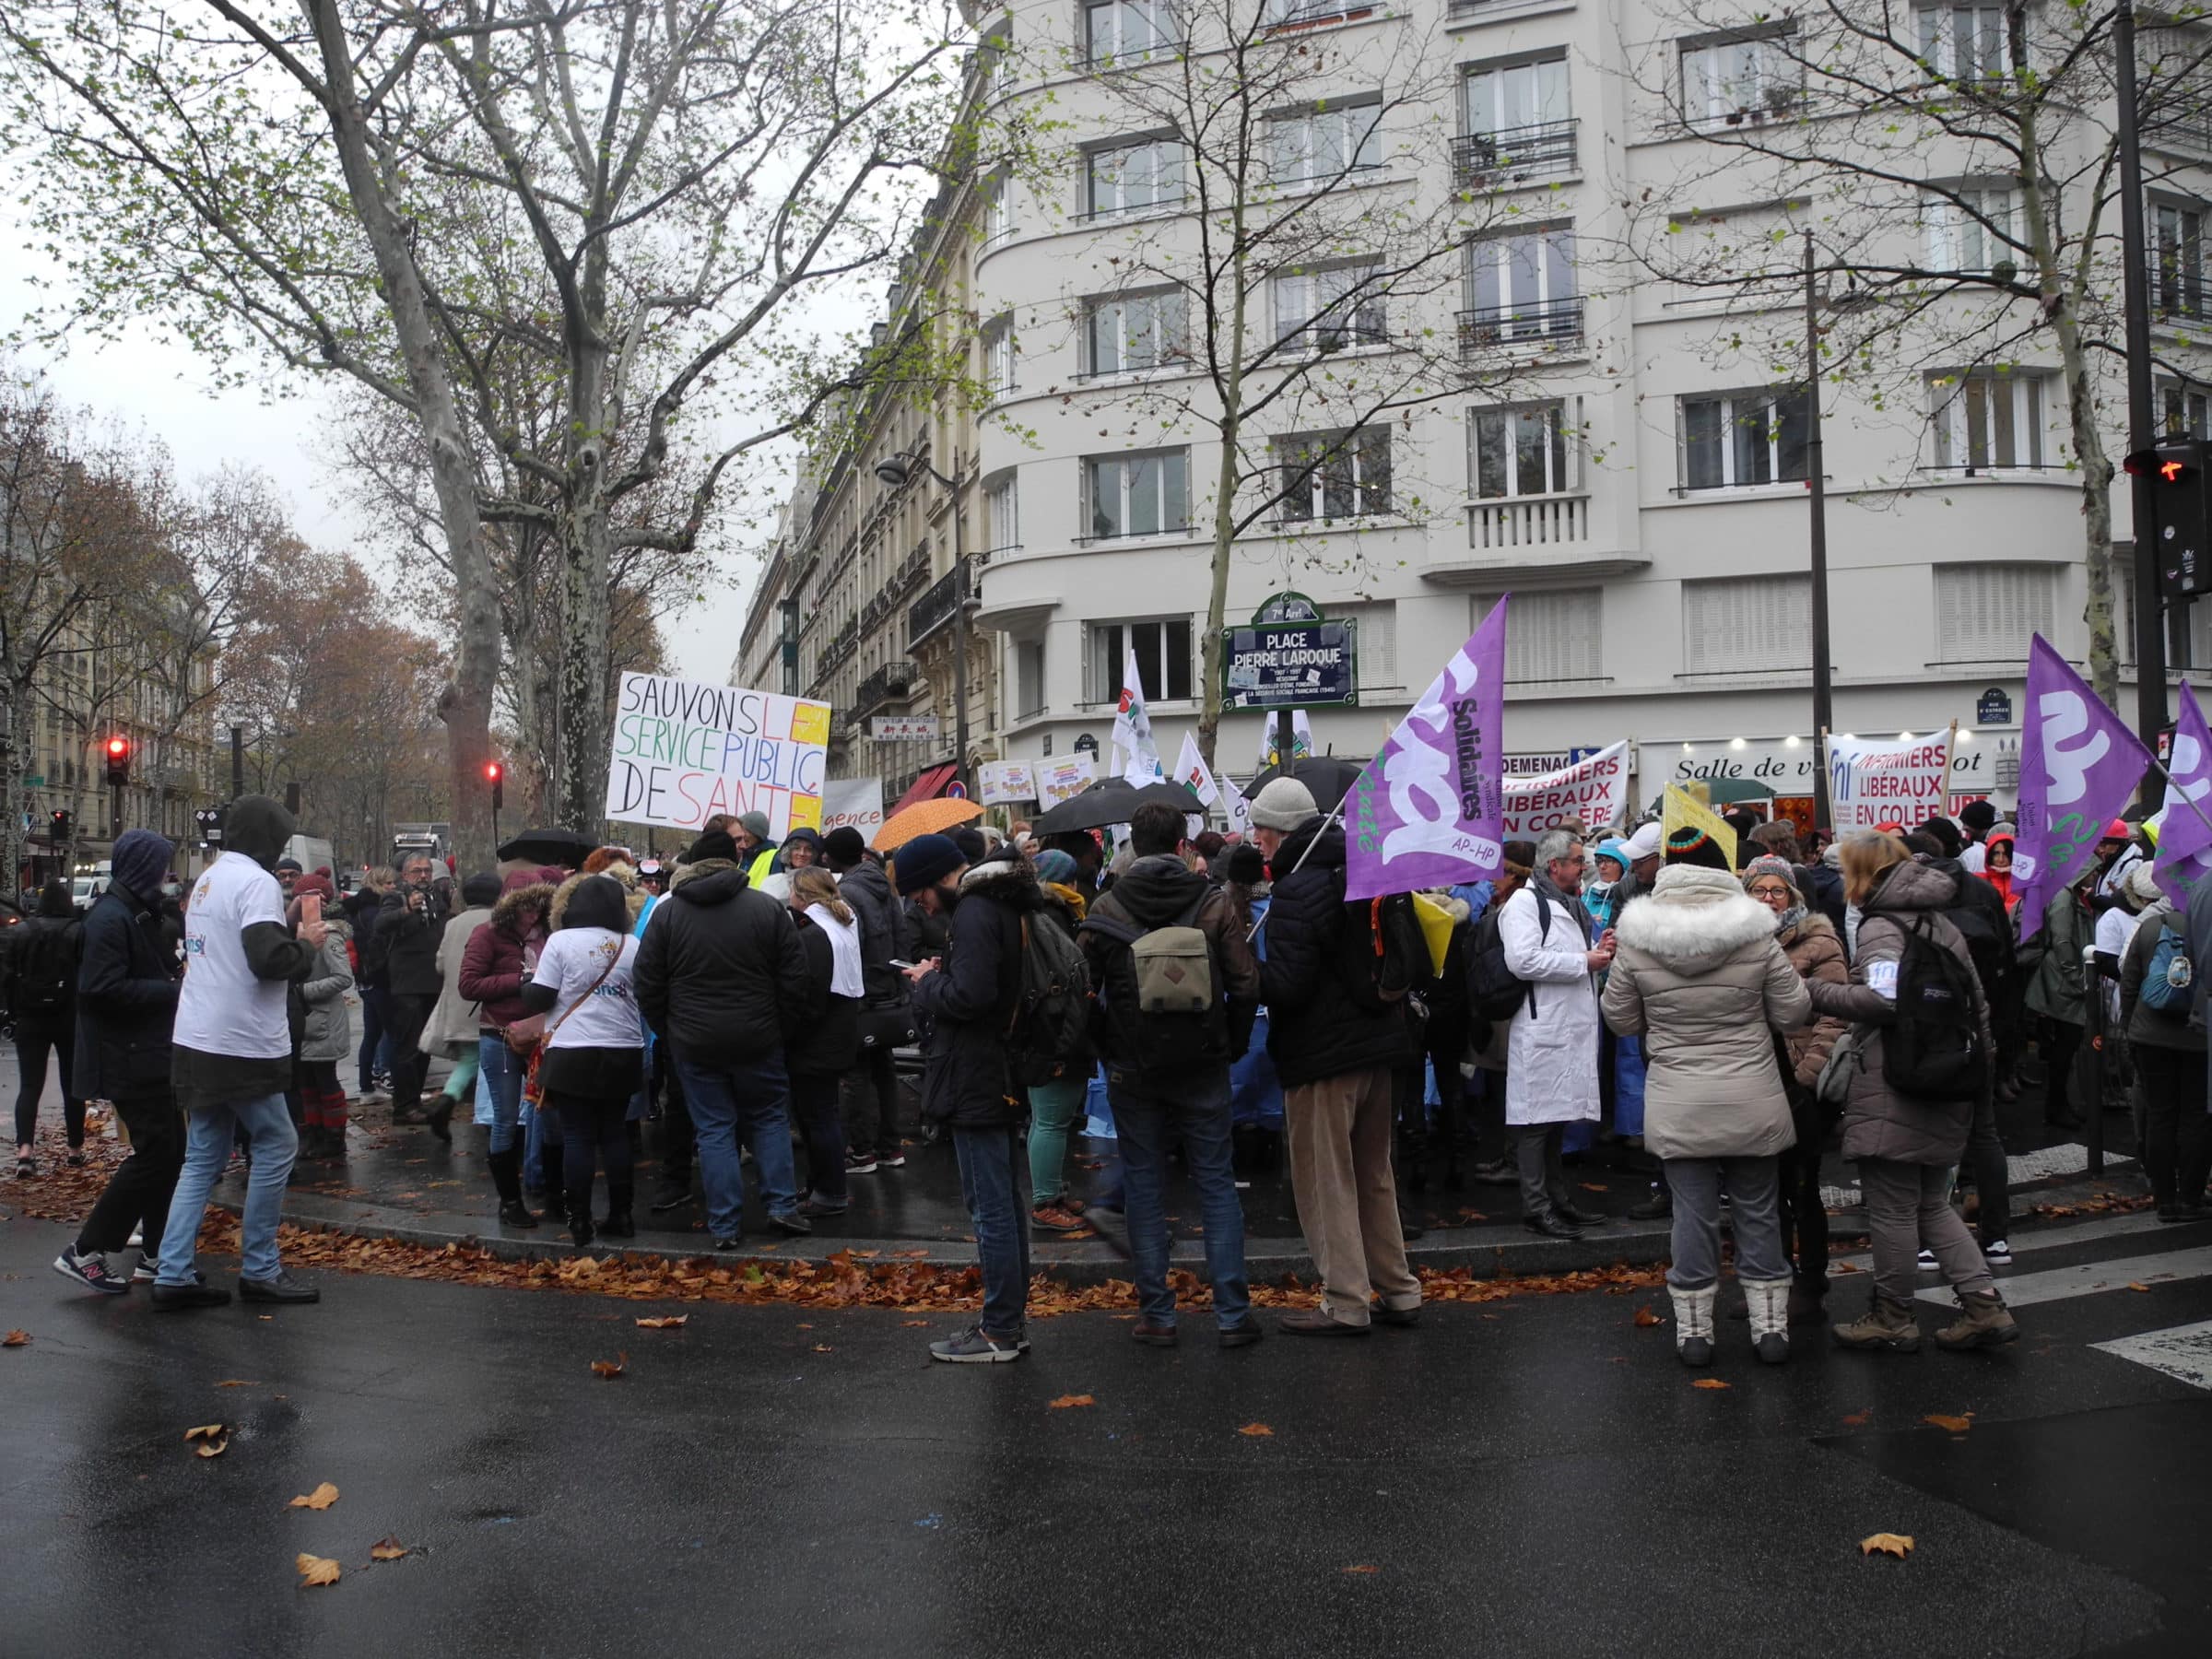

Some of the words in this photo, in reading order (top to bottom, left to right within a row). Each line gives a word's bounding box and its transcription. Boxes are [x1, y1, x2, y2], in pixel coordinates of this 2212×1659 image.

[1266, 632, 1307, 649] PLACE
[1234, 652, 1278, 668] PIERRE
[1282, 648, 1342, 665] LAROQUE
[621, 676, 760, 735] SAUVONS
[762, 697, 815, 745] LE
[616, 714, 723, 771] SERVICE
[722, 732, 823, 794] PUBLIC
[1453, 699, 1482, 821] Solidaires
[1675, 759, 1743, 781] Salle
[1754, 757, 1785, 777] de
[611, 759, 672, 819] DE
[1501, 781, 1612, 812] IBÉRAUX
[1860, 771, 1943, 797] LIBÉRAUX
[1502, 817, 1520, 833] N
[1528, 804, 1614, 832] COÈRE
[1856, 805, 1875, 825] EN
[1452, 838, 1495, 861] AP-HP
